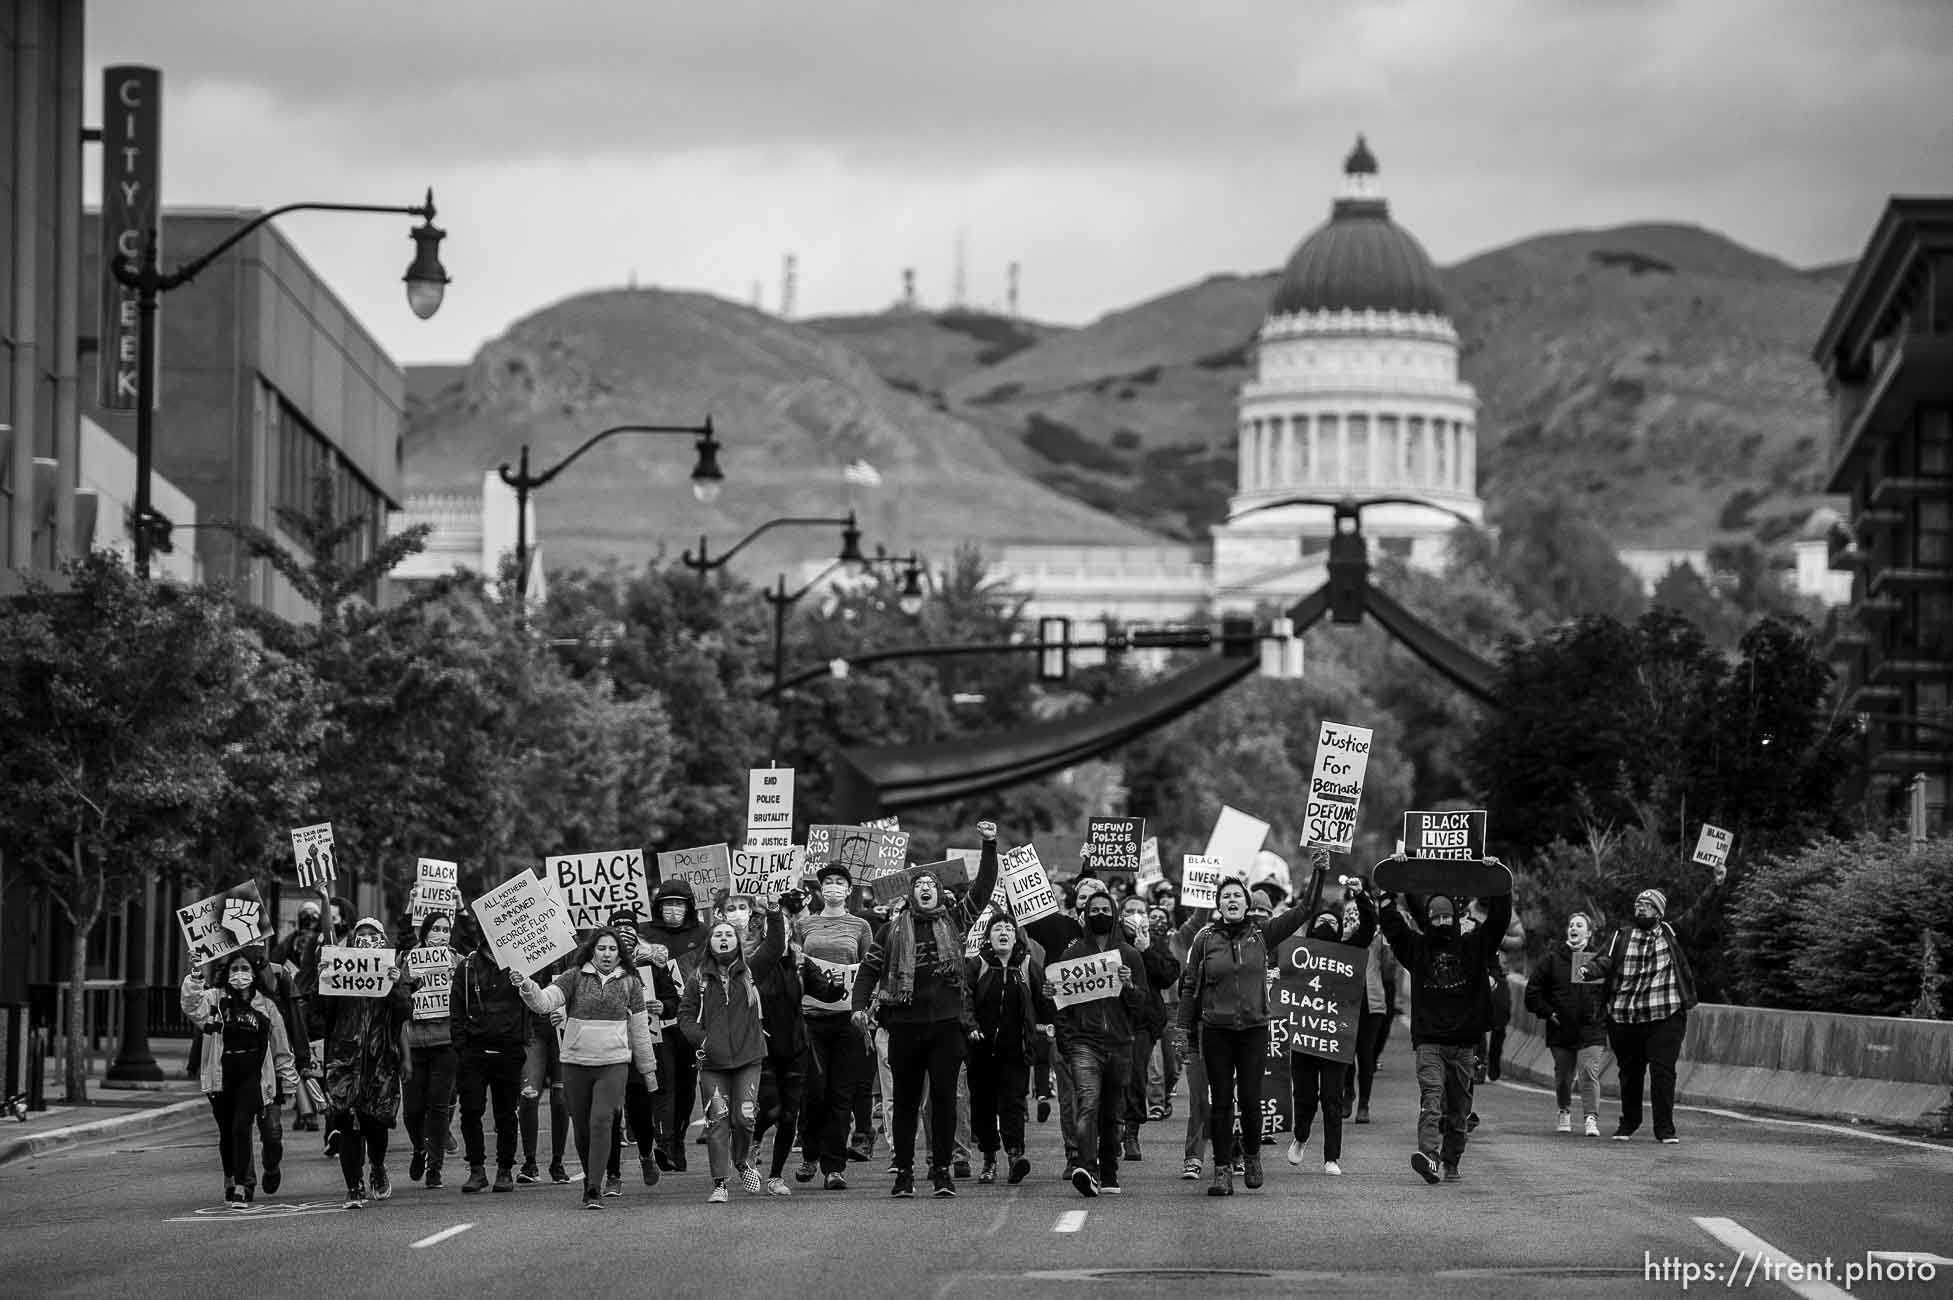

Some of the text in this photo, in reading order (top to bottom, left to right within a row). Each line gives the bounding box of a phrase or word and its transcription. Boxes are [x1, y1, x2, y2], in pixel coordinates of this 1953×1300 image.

[119, 79, 142, 208] CITY
[117, 229, 139, 397] CEEK
[1321, 730, 1369, 753] Justice
[1323, 755, 1351, 774] For
[764, 776, 777, 785] END
[1313, 777, 1362, 795] Bernardo
[756, 794, 781, 804] POLICE
[753, 812, 789, 822] BRUTALITY
[1308, 802, 1357, 822] DEFUND
[1091, 822, 1134, 833] DEFUND
[1309, 818, 1354, 842] SLCPD
[1422, 814, 1470, 829] BLACK
[747, 837, 788, 847] NO JUSTICE
[809, 829, 829, 841] NO
[881, 834, 906, 847] NO
[1092, 831, 1132, 843] POLICE
[1425, 831, 1465, 846] LIVES
[878, 846, 906, 860] KIDS
[1098, 843, 1123, 856] HEX
[1416, 848, 1473, 861] MATTER
[1696, 850, 1723, 865] MATTE
[733, 850, 796, 876] SILENCE
[1002, 847, 1037, 872] BLACK
[1090, 854, 1139, 868] RACISTS
[1188, 856, 1220, 865] BLACK
[421, 864, 455, 881] BLACK
[557, 854, 643, 889] BLACK
[759, 873, 769, 881] IS
[1189, 871, 1216, 884] LIVES
[735, 876, 791, 895] VIOLENCE
[1013, 872, 1042, 894] LIVES
[422, 887, 452, 901] LIVES
[484, 879, 528, 911] ALL MOTHERS
[500, 895, 519, 910] WERE
[567, 882, 639, 907] LIVES
[493, 896, 536, 926] SUMMONED
[1013, 890, 1056, 917] MATTER
[180, 901, 216, 925] BLACK
[511, 912, 530, 927] WHEN
[187, 920, 221, 943] LIVE
[495, 908, 556, 948] GEORGE FLOYD
[512, 923, 550, 950] CALLED OUT
[523, 935, 548, 953] FOR HIS
[525, 941, 557, 963] MOMMA
[410, 949, 448, 964] BLACK
[1291, 946, 1354, 978] QUEERS
[331, 974, 384, 991] SHOOT
[422, 973, 448, 987] IVES
[1062, 975, 1114, 996] SHOOT
[1308, 975, 1322, 992] 4
[412, 994, 449, 1010] MATTE
[1280, 989, 1339, 1015] BLACK
[1289, 1011, 1338, 1034] LIVES
[1292, 1032, 1340, 1053] ATTER
